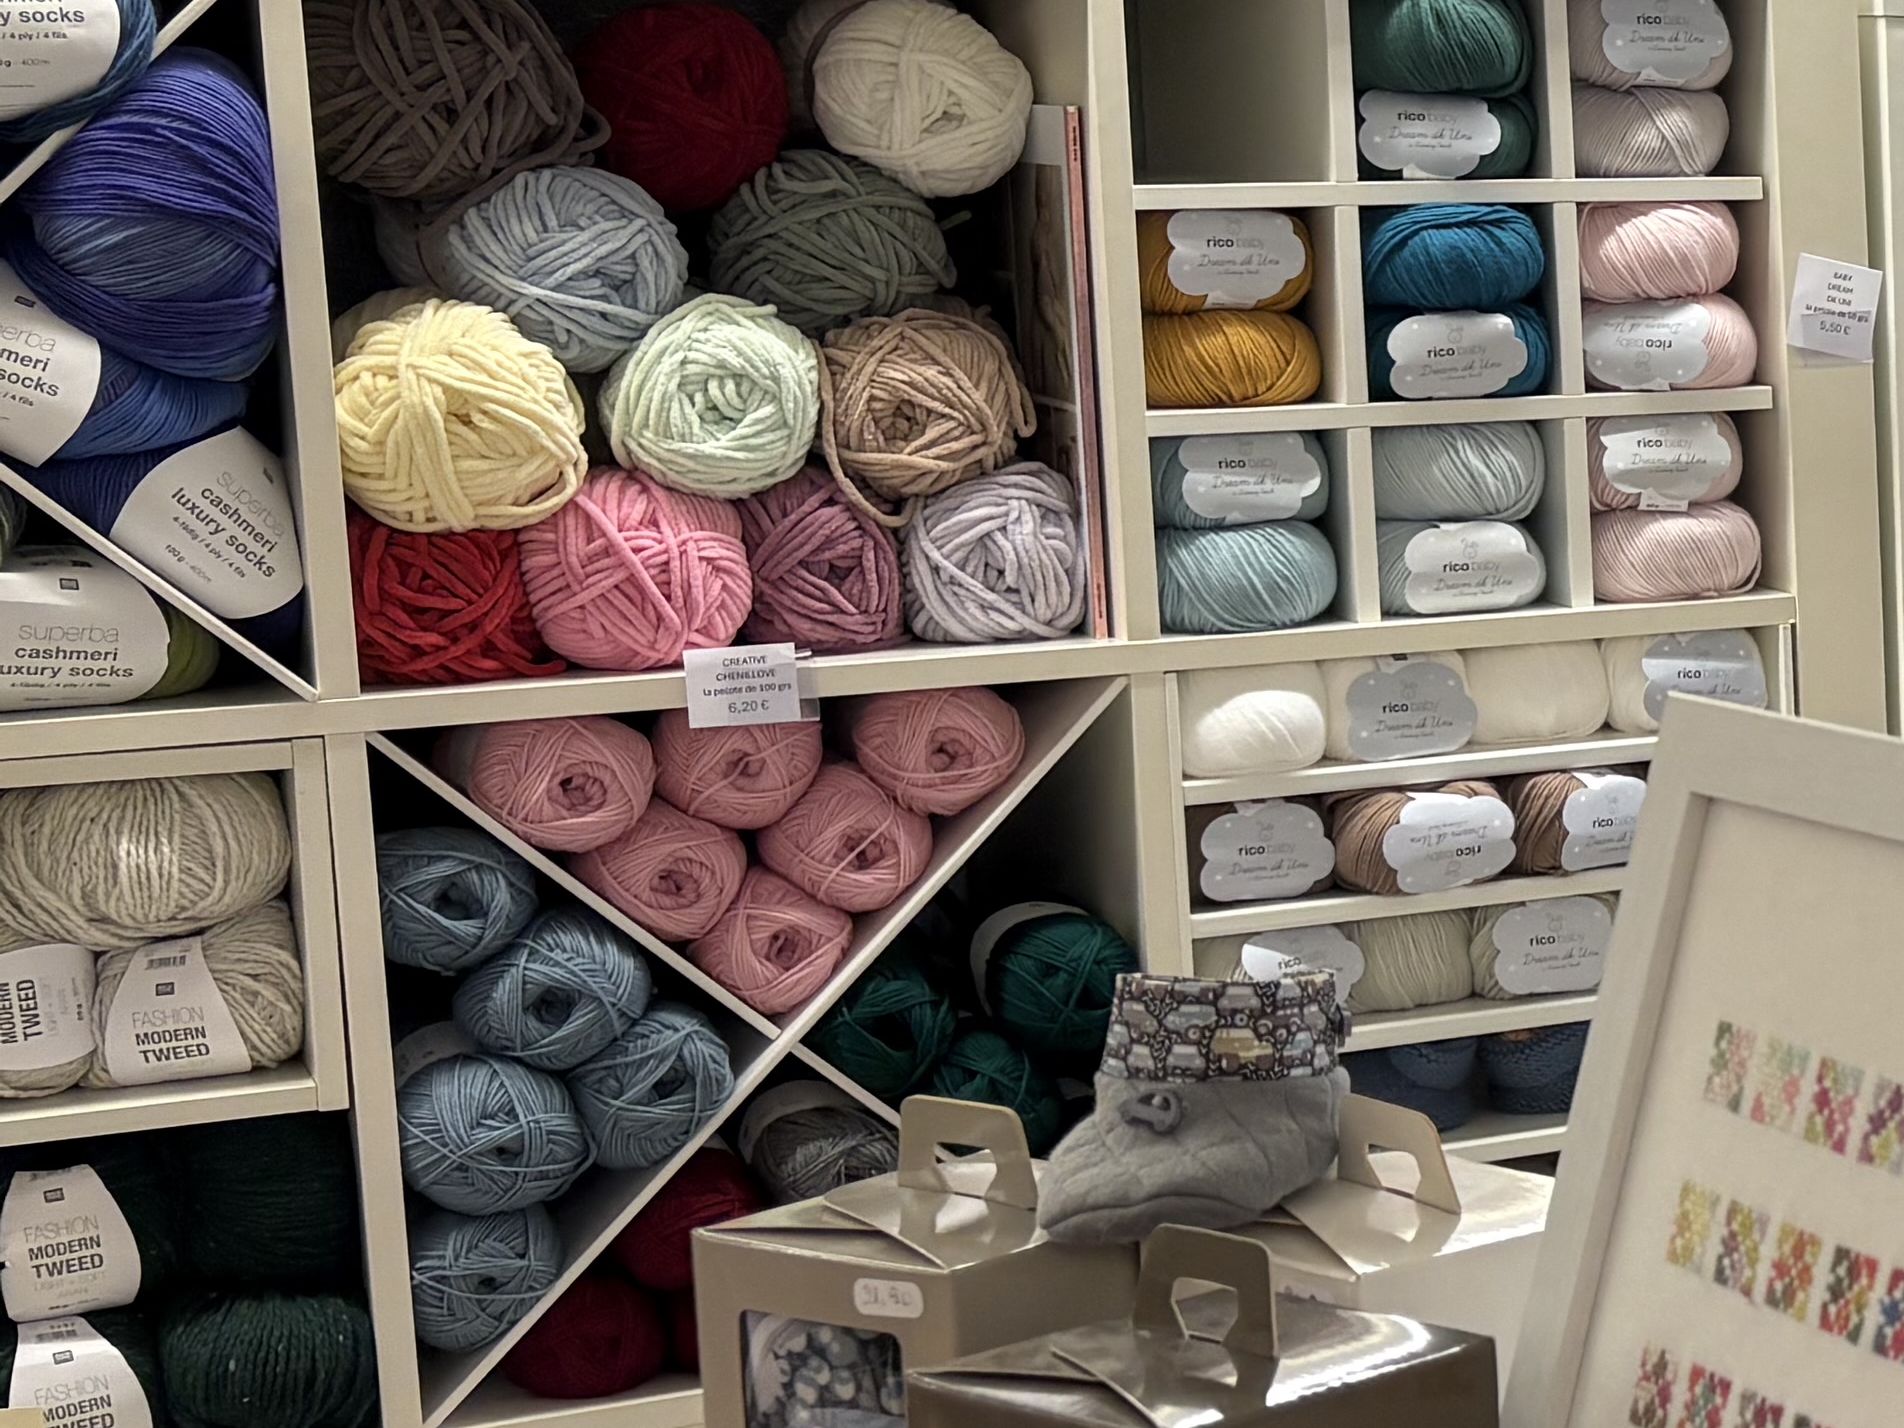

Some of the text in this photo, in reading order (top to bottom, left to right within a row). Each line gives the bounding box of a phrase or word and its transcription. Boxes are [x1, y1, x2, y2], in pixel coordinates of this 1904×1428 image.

[18, 7, 85, 23] socks
[1636, 13, 1662, 25] rico
[1398, 110, 1426, 122] rico
[1207, 236, 1234, 248] rico
[1427, 345, 1455, 358] rico
[1645, 338, 1673, 351] rico
[0, 369, 60, 397] socks
[1637, 437, 1663, 448] rico
[1218, 457, 1246, 469] rico
[217, 471, 284, 537] superba
[201, 487, 278, 553] cashmeri
[171, 487, 226, 536] luxury
[225, 534, 276, 578] socks
[1443, 561, 1470, 573] rico
[18, 624, 119, 644] superba
[14, 646, 119, 662] cashmeri
[722, 655, 767, 667] CREATIVE
[68, 665, 134, 678] socks
[1677, 668, 1701, 679] rico
[759, 683, 776, 692] 100
[728, 700, 770, 714] 6,20 €
[1381, 701, 1409, 715] rico
[1237, 844, 1265, 857] rico
[1529, 933, 1555, 947] rico
[16, 978, 43, 1041] TWEED
[132, 1006, 205, 1029] FASHION
[135, 1025, 207, 1047] MODERN
[138, 1042, 211, 1064] TWEED
[23, 1215, 100, 1243] FASHION
[28, 1234, 102, 1262] MODERN
[31, 1252, 104, 1279] TWEED
[34, 1375, 109, 1404] FASHION
[43, 1393, 112, 1422] MODERN
